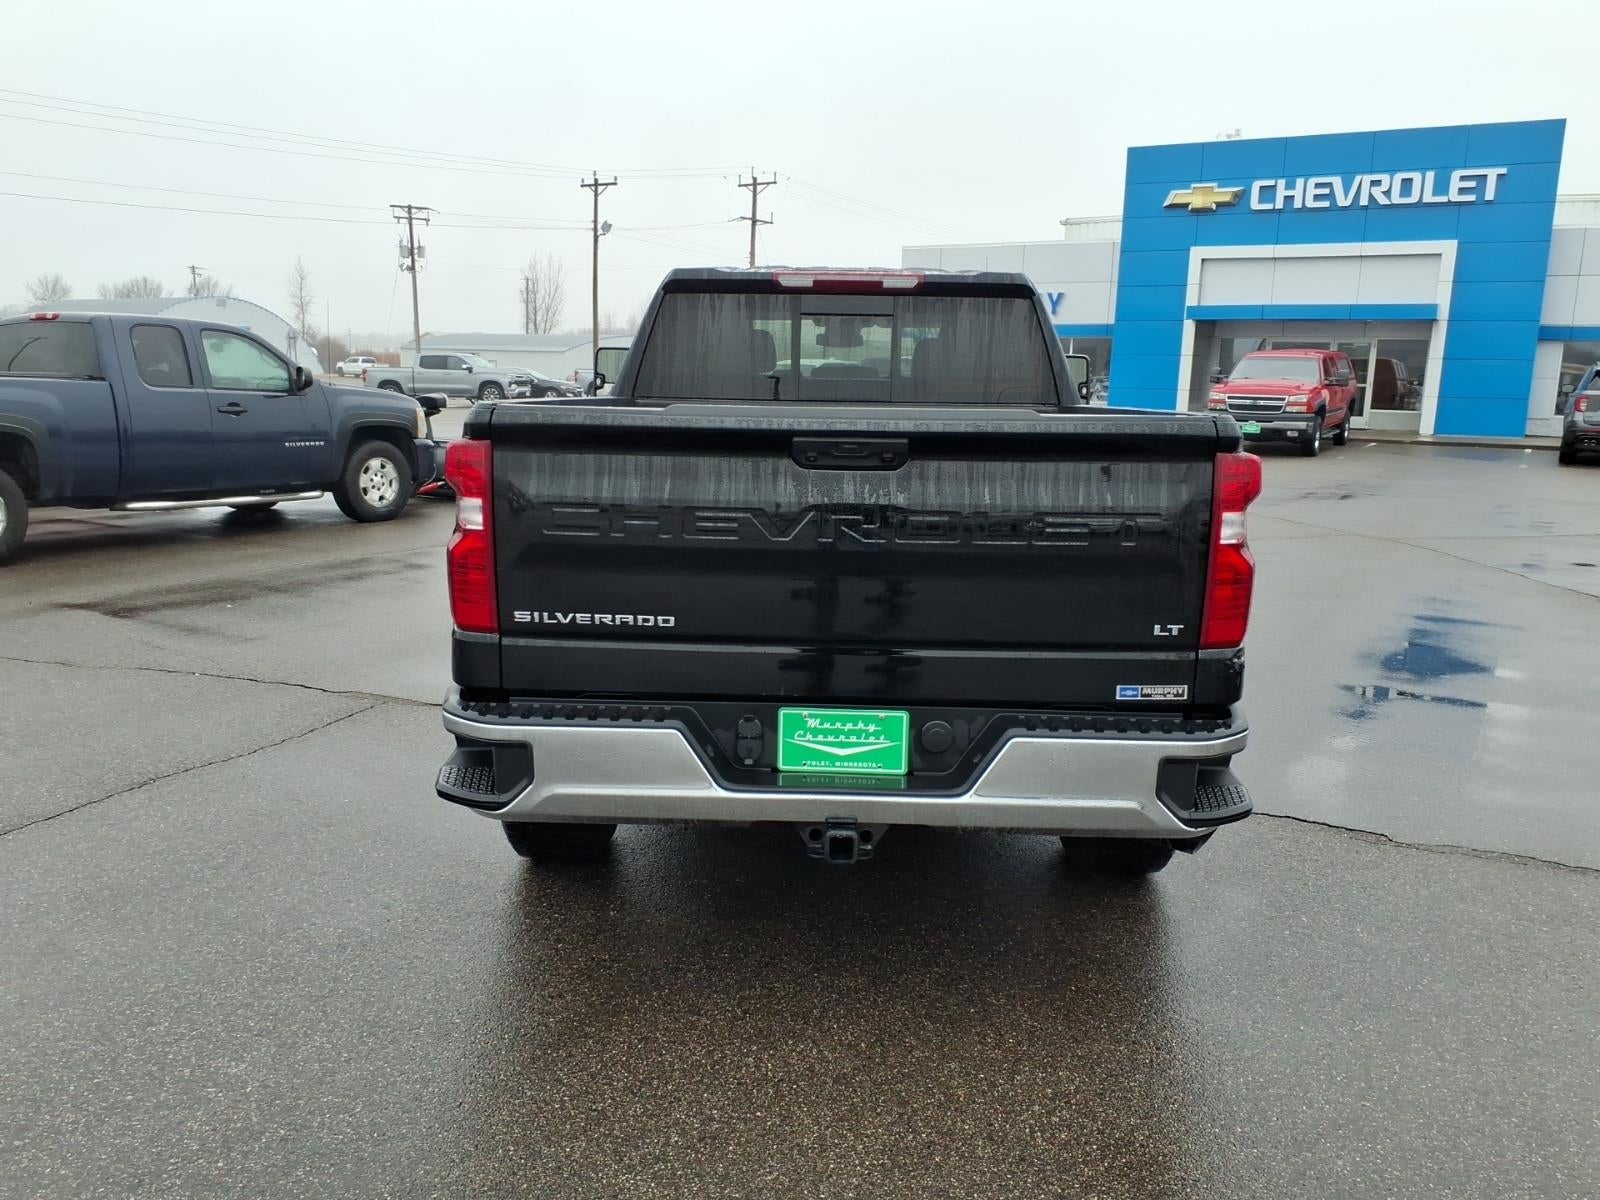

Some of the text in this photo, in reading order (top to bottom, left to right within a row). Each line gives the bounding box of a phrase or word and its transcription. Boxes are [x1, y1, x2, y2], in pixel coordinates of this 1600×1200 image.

[1250, 168, 1507, 210] CHEVROLET
[513, 610, 676, 627] SILVERADO
[1153, 624, 1184, 635] LT
[804, 718, 882, 732] Murphy
[794, 730, 890, 742] Chevrolet
